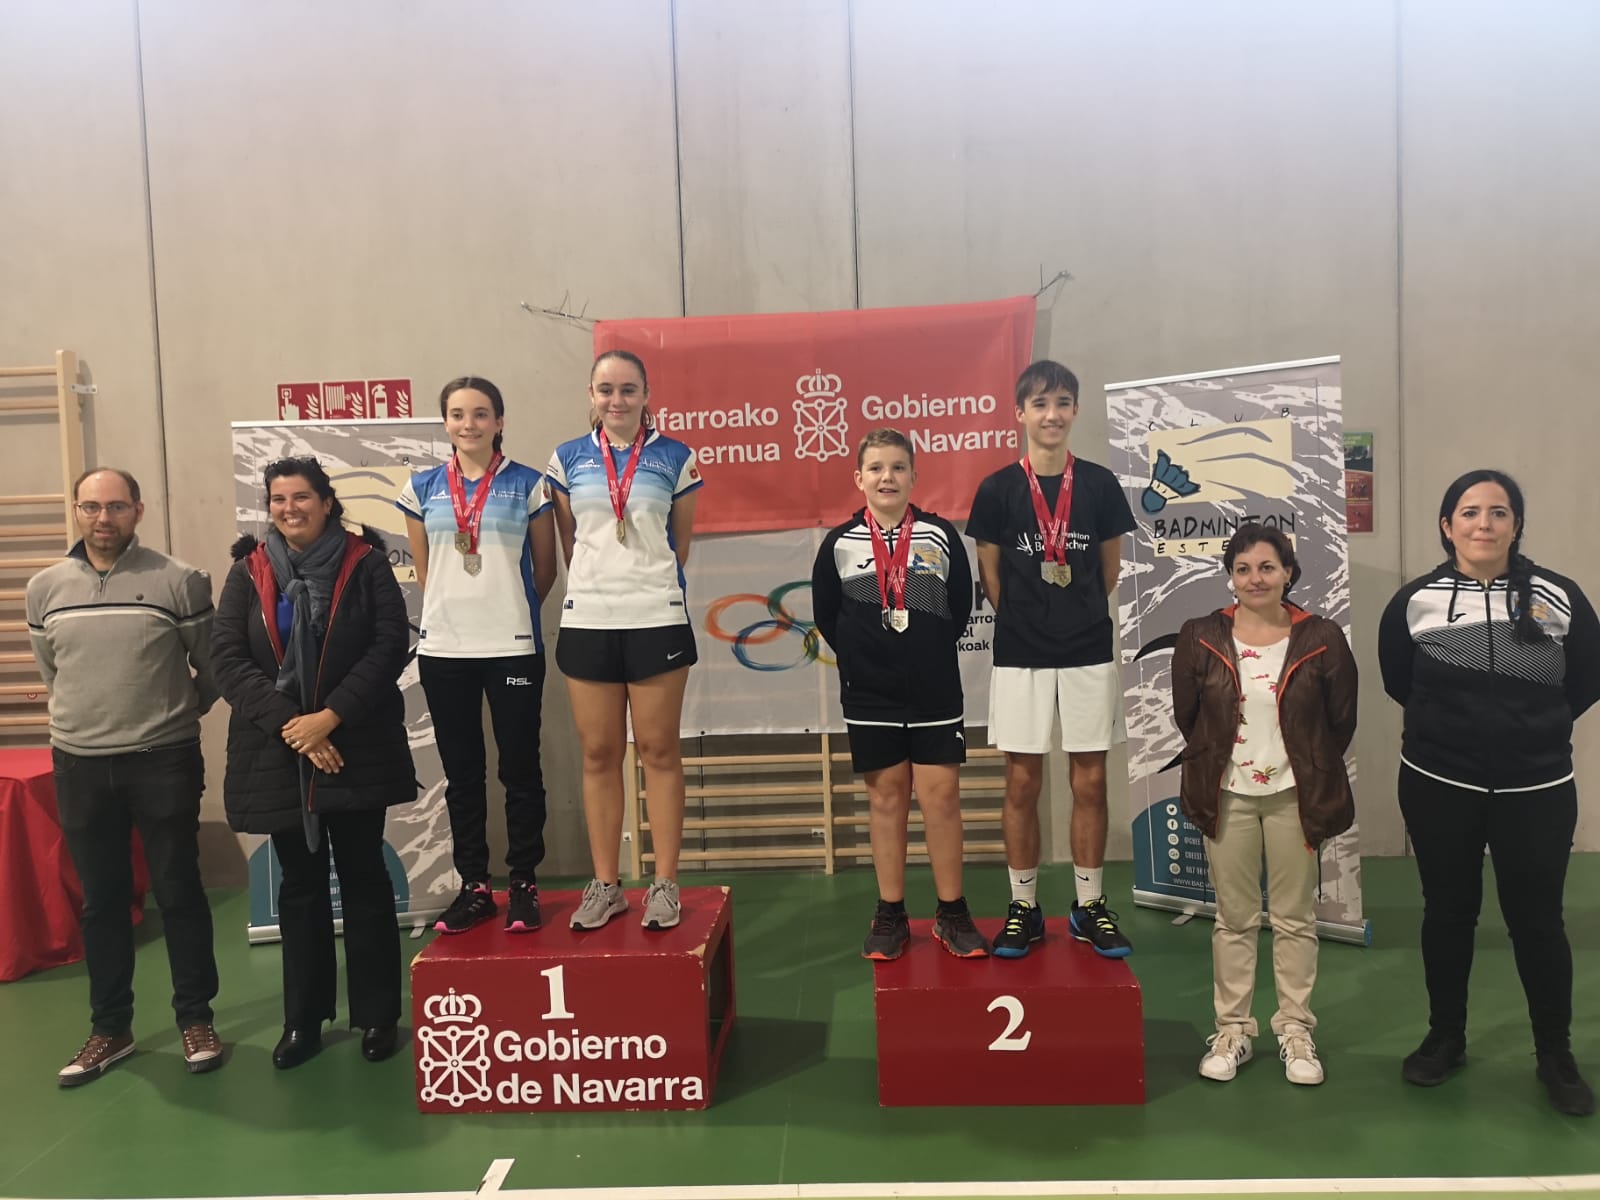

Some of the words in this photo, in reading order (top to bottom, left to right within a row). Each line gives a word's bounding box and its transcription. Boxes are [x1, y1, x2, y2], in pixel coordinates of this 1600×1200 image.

[652, 402, 779, 432] farroako
[861, 393, 996, 421] Gobierno
[689, 442, 780, 465] ernua
[909, 428, 1018, 454] Navarra
[506, 677, 533, 686] RSL
[540, 964, 575, 1020] 1
[986, 995, 1032, 1051] 2
[493, 1029, 667, 1062] Gobierno
[496, 1073, 543, 1105] de
[553, 1073, 704, 1104] Navarra
